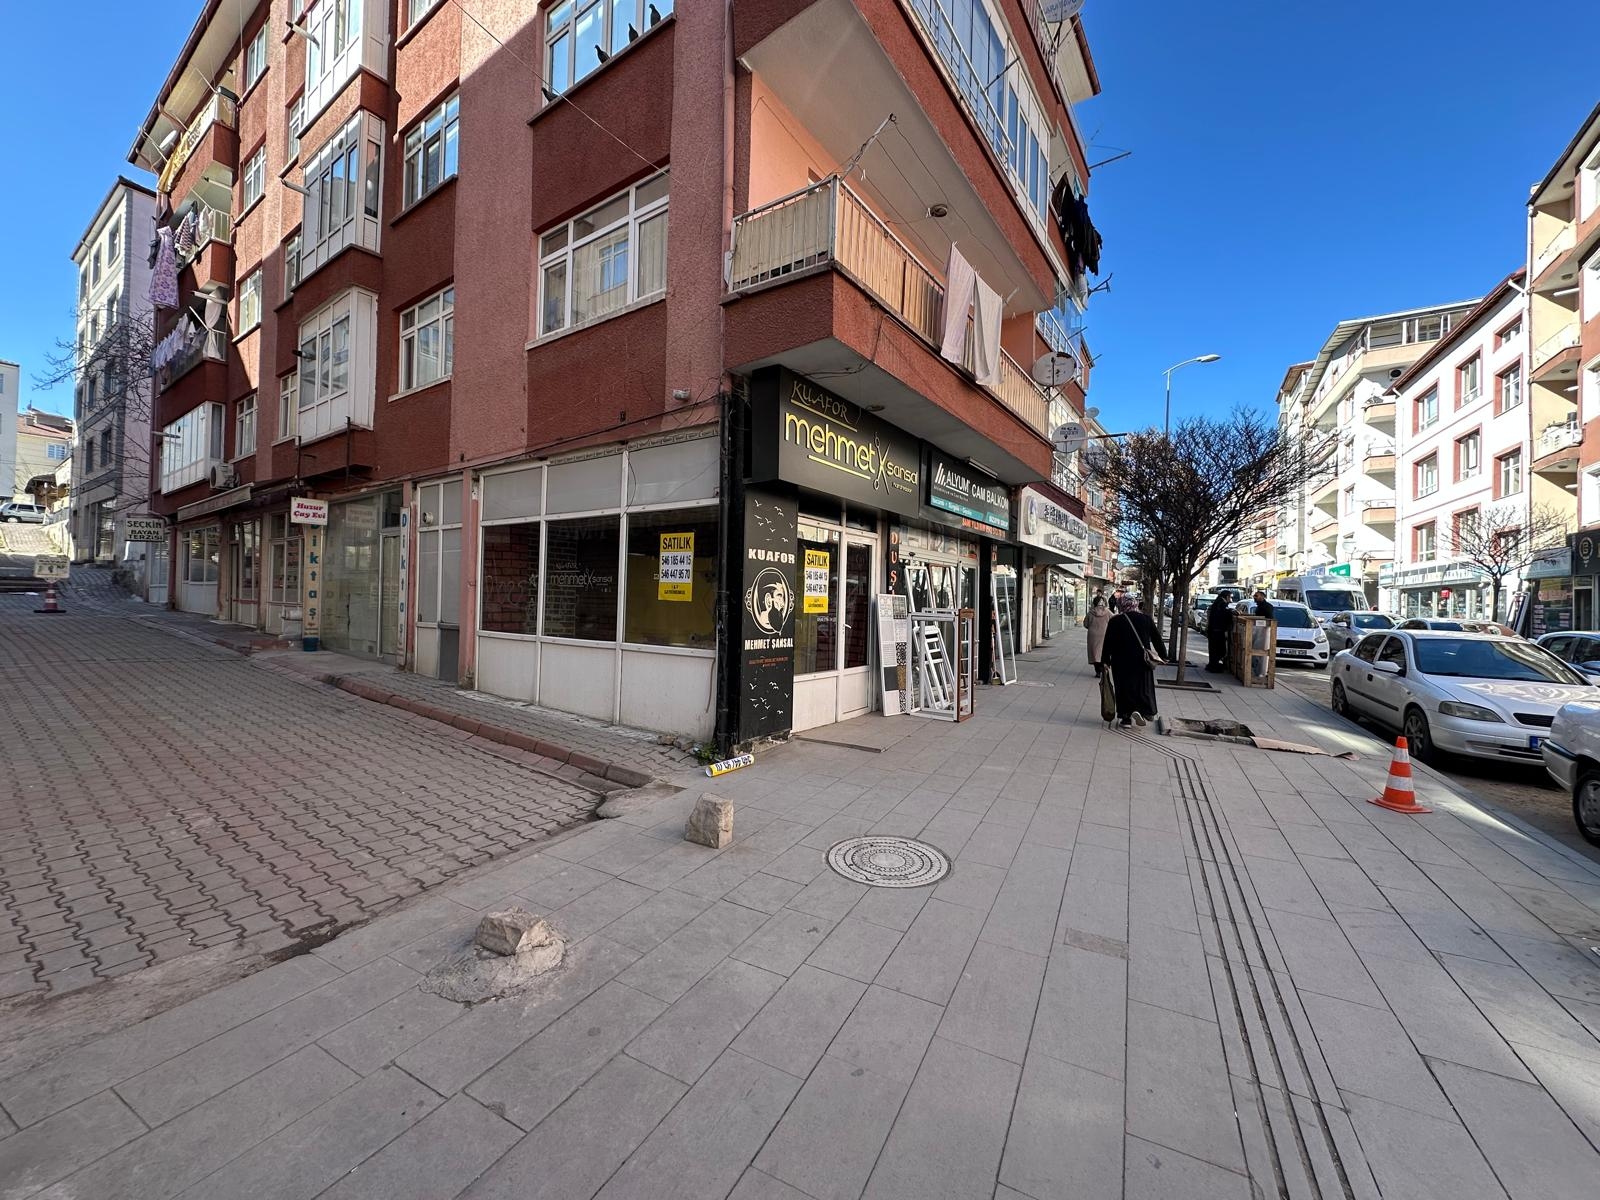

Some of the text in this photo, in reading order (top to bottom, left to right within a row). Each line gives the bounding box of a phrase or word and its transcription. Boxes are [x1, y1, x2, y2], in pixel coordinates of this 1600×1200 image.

[785, 411, 876, 474] mehmet
[971, 484, 986, 501] CAM
[986, 489, 1010, 510] BALKON
[296, 502, 323, 511] Huzur
[662, 537, 691, 550] SATILIK
[748, 548, 796, 564] KUAFOR
[806, 553, 828, 567] SATILIK
[661, 568, 670, 579] 546
[744, 638, 794, 650] MEHMET ŞANSAL
